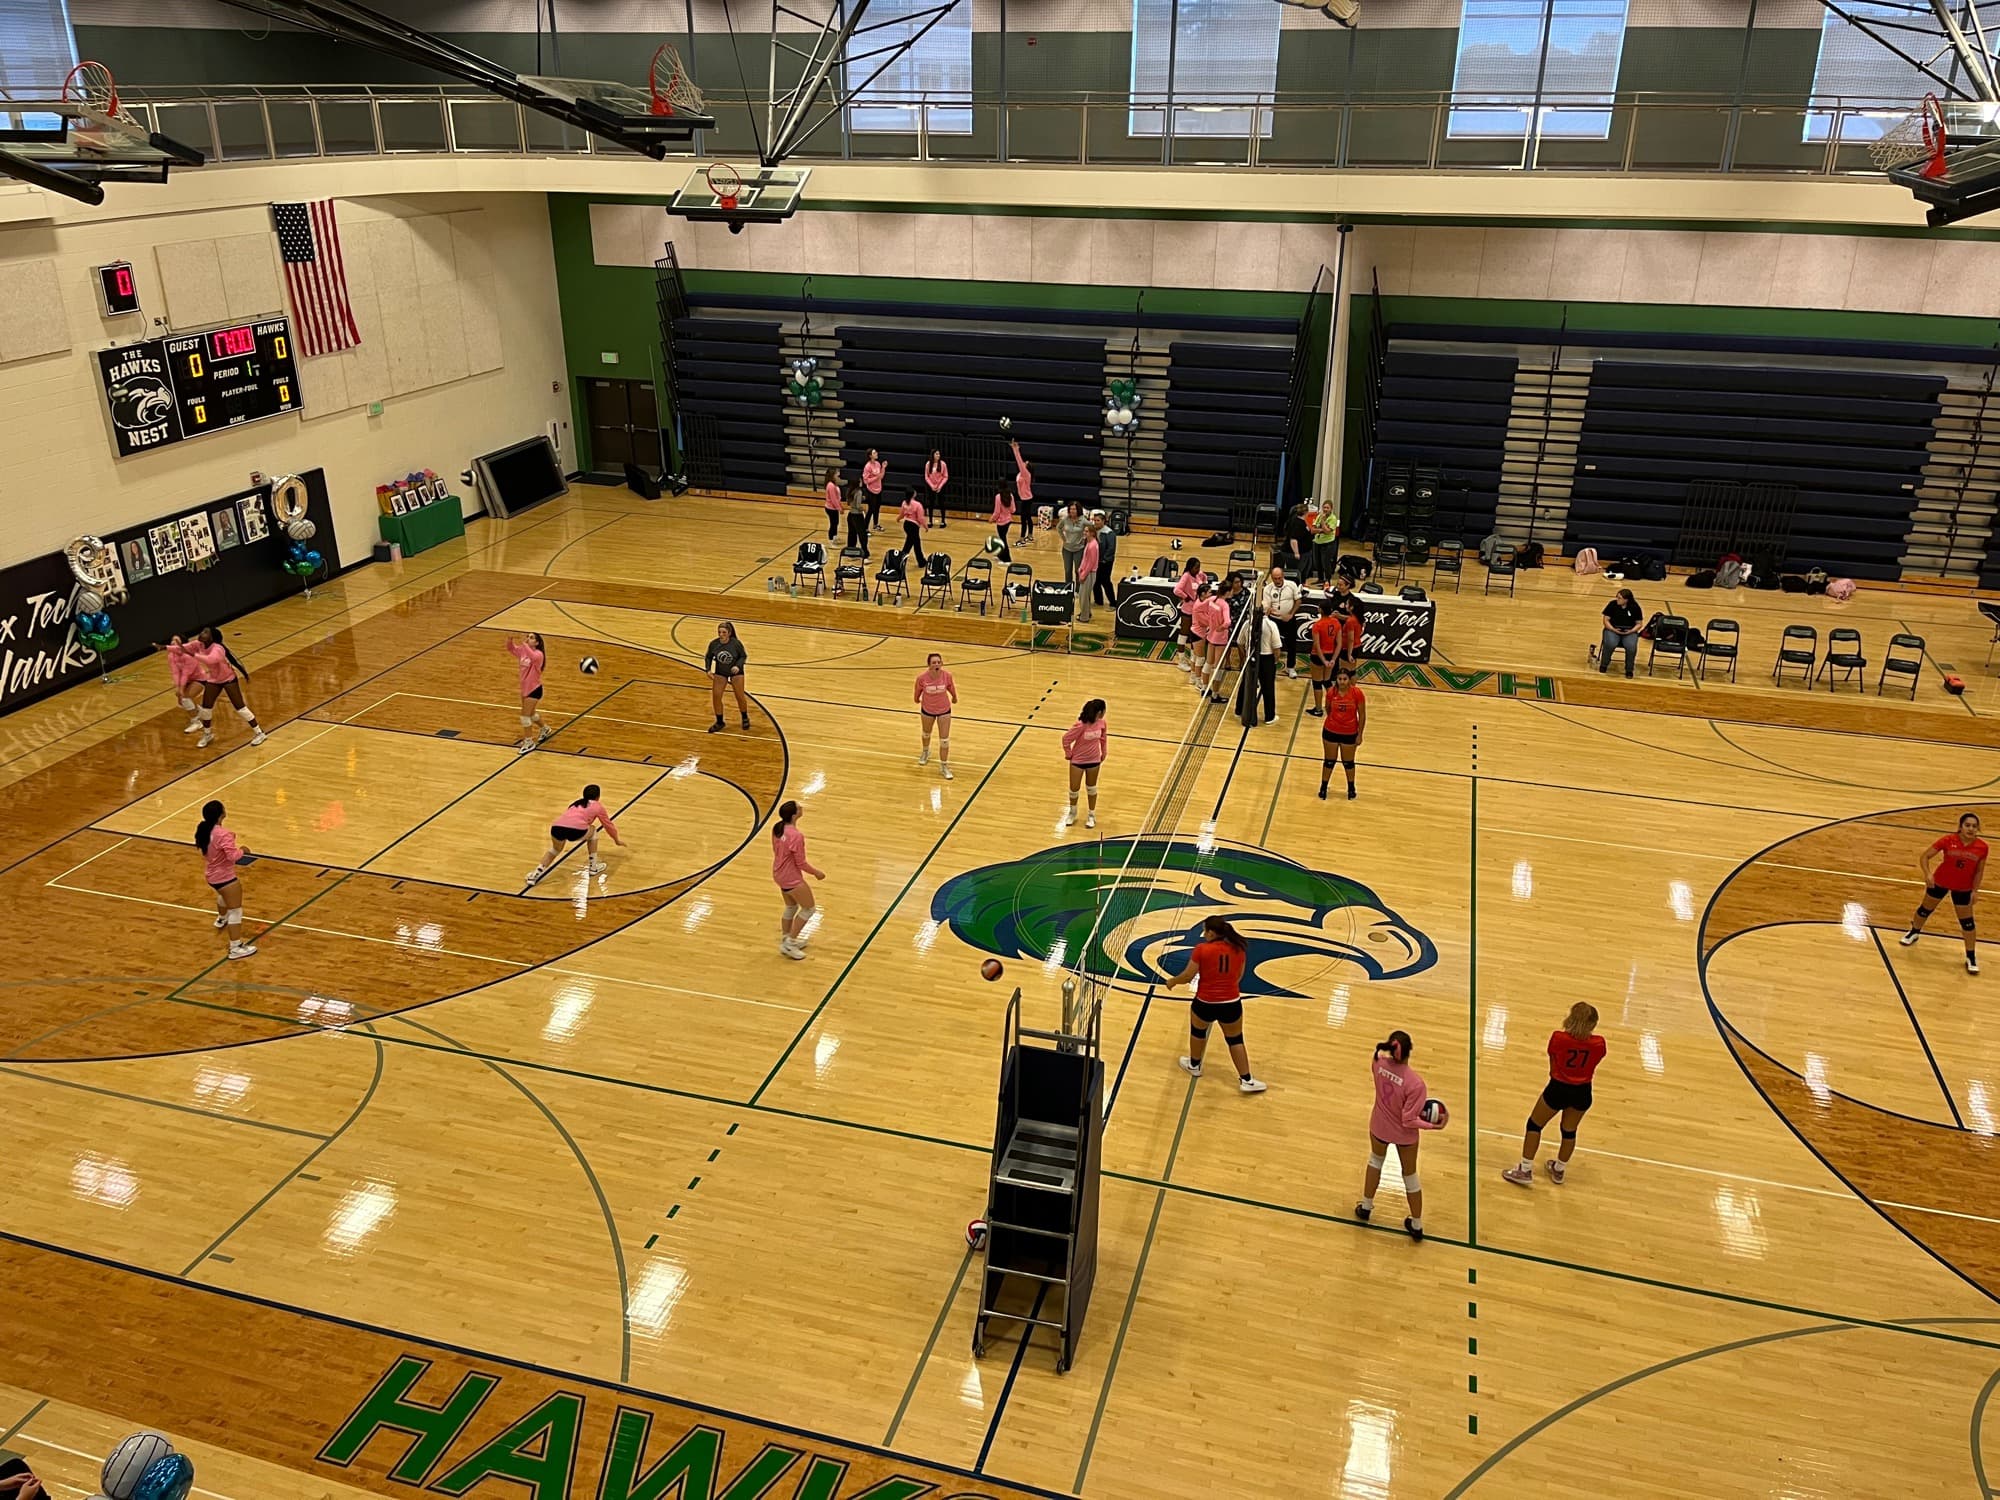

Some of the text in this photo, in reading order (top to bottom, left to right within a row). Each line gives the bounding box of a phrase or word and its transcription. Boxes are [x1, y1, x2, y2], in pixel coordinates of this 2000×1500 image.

[116, 270, 132, 296] 0
[257, 322, 285, 336] HAWKS
[122, 349, 143, 361] THE
[169, 338, 200, 354] GUEST
[274, 336, 287, 359] 0
[109, 359, 162, 382] HAWKS
[189, 353, 204, 378] 0
[213, 367, 240, 380] PERIOD
[272, 376, 289, 385] FOULS
[187, 396, 206, 406] FOULS
[279, 384, 290, 402] 0
[195, 404, 207, 424] 0
[128, 422, 169, 447] NEST
[1038, 603, 1064, 613] molten
[1391, 608, 1430, 627] Tech
[1360, 628, 1427, 658] awks
[1218, 953, 1230, 974] 11
[1566, 1049, 1589, 1068] 27
